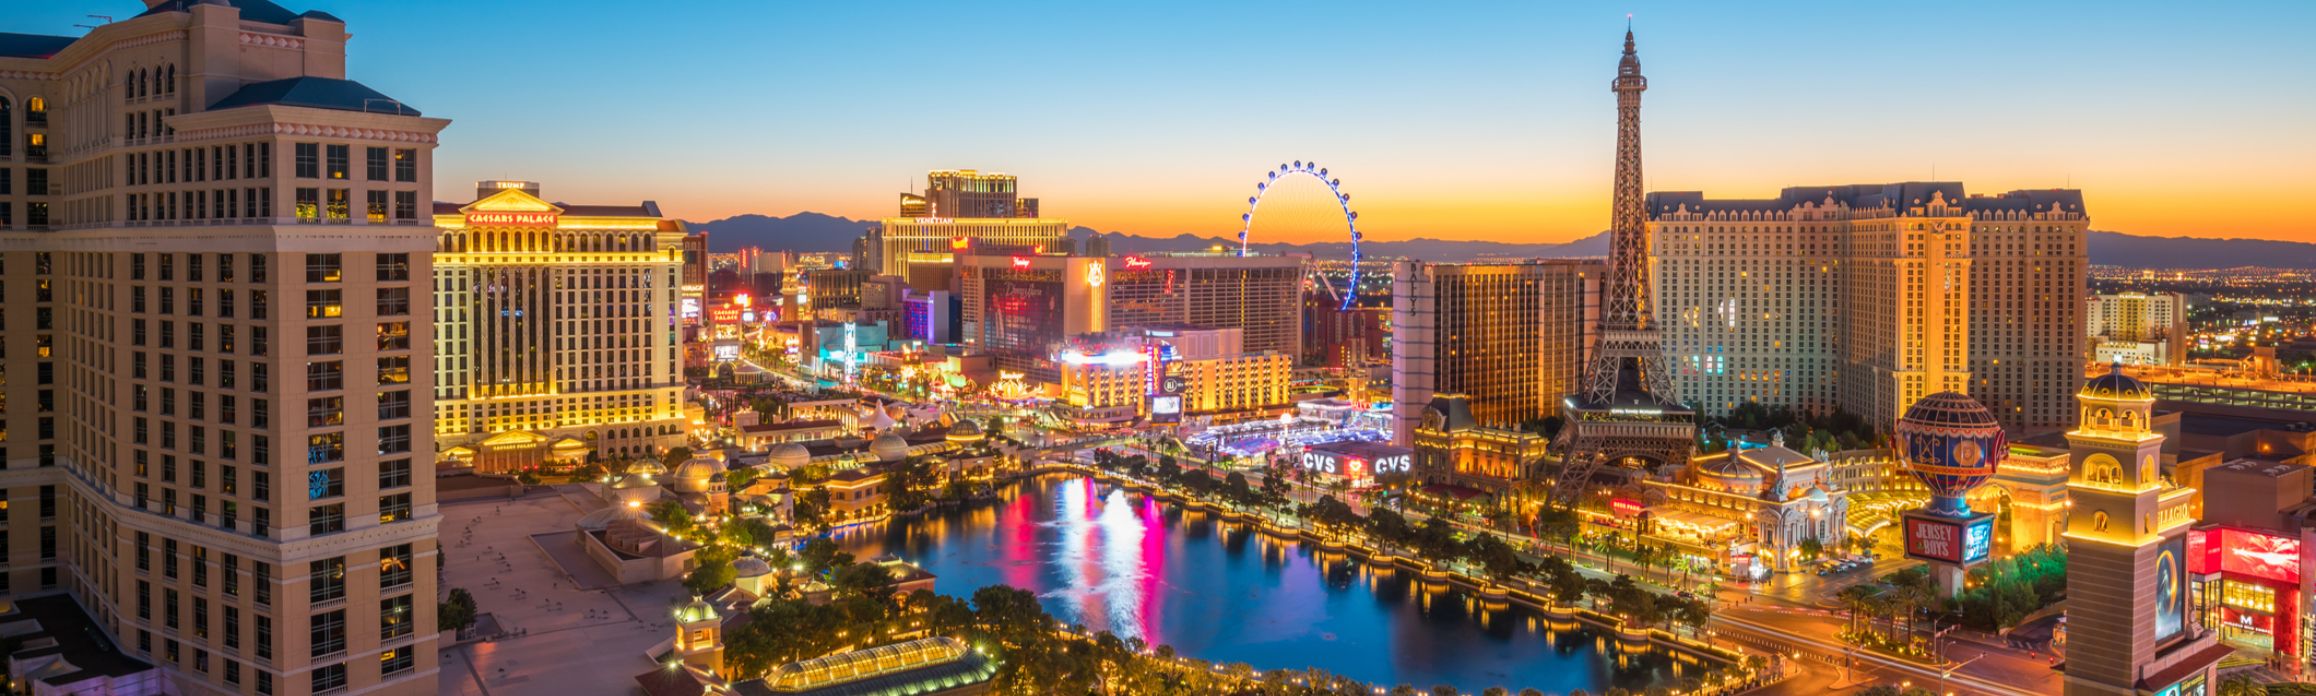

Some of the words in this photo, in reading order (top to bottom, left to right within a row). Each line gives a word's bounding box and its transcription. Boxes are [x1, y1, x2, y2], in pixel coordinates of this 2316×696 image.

[469, 214, 513, 223] CAESARS
[516, 214, 554, 223] PALACE
[1303, 452, 1335, 473] CVS
[1375, 455, 1410, 473] CVS
[1916, 523, 1952, 541] JERSEY
[1924, 540, 1949, 556] BOYS
